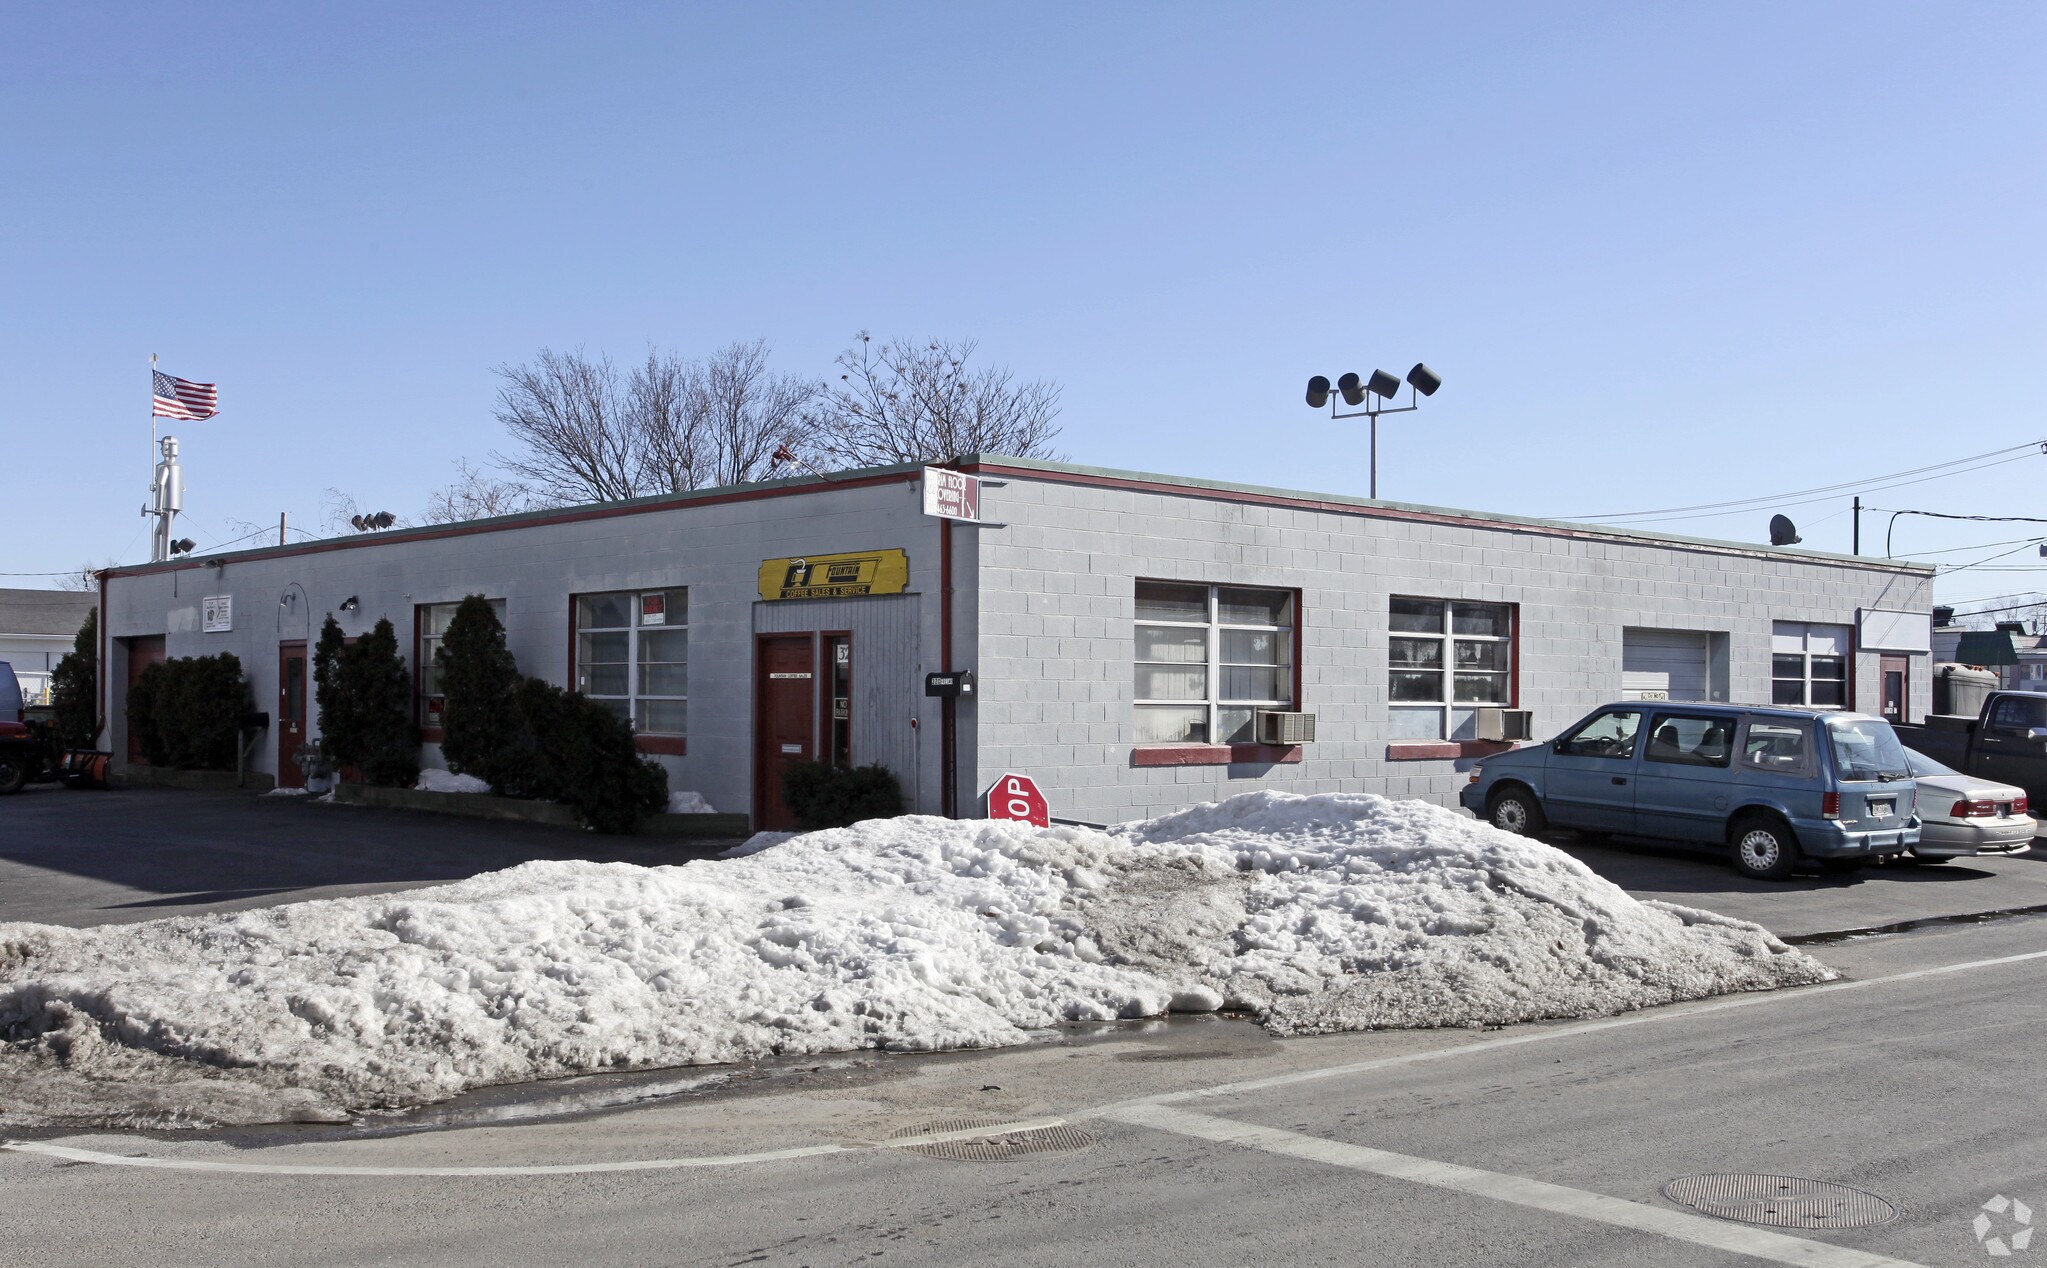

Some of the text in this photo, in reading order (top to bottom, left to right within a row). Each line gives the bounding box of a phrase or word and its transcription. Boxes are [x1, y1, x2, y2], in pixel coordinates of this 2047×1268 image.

[786, 586, 866, 598] COFFEE SALES & SERVICE
[1007, 778, 1029, 817] OP
